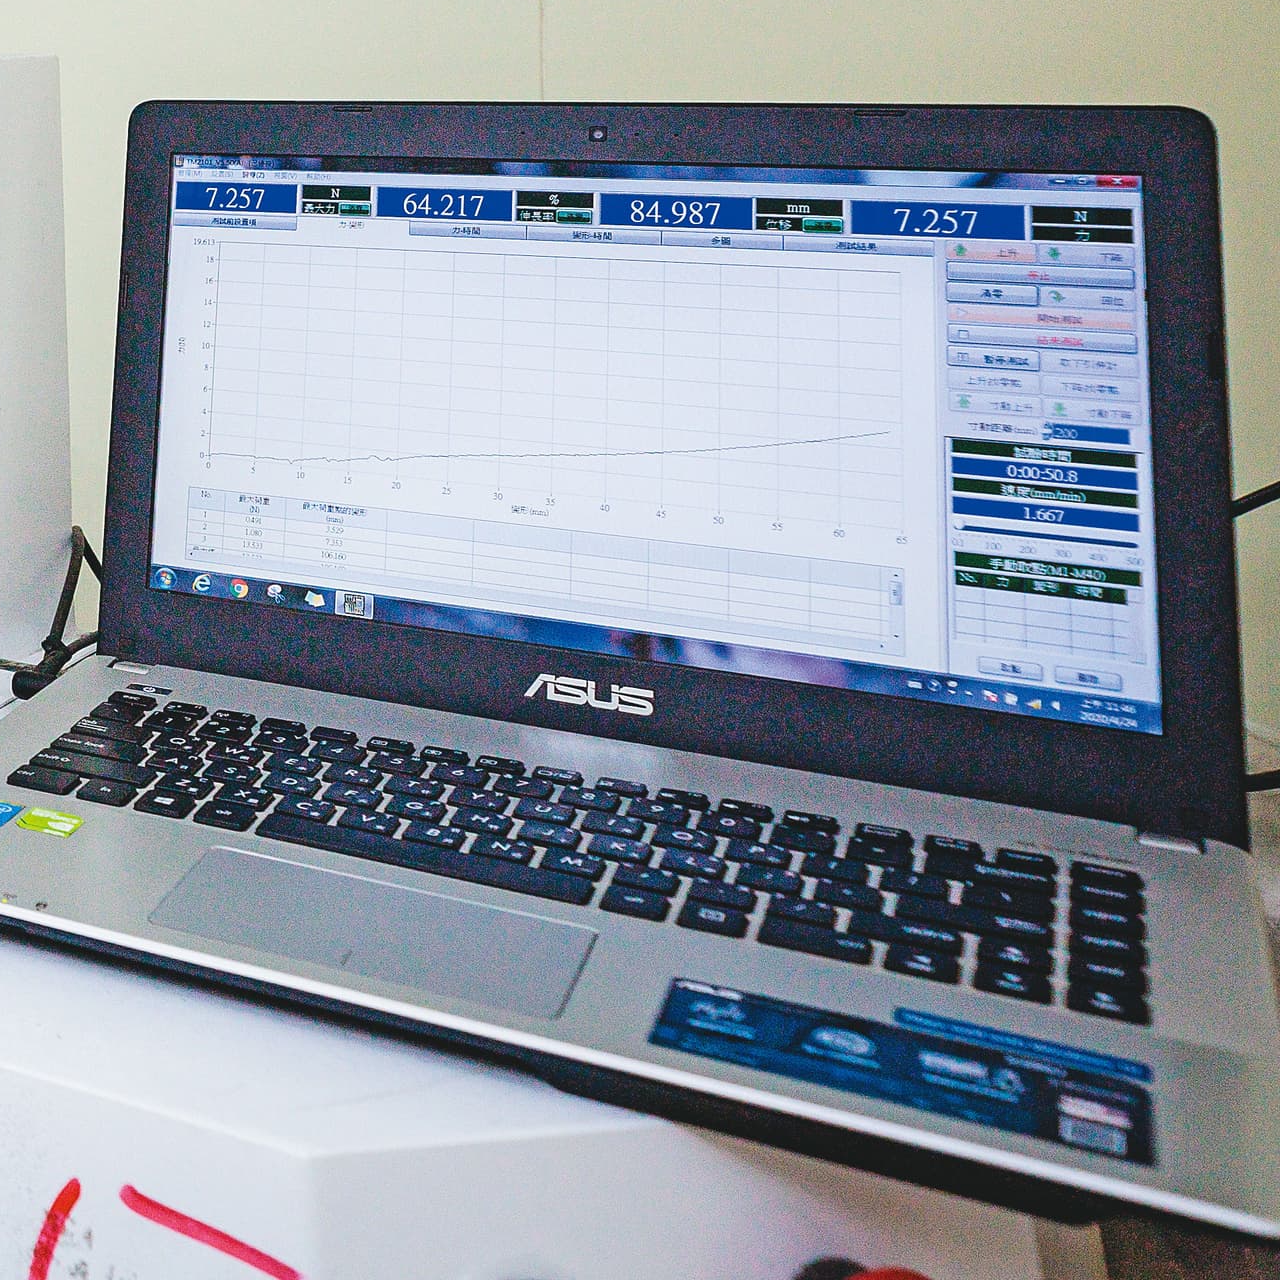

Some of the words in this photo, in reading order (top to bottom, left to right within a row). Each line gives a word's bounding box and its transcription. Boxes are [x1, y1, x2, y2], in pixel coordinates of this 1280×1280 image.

[205, 187, 265, 209] 7.257
[331, 188, 340, 199] N
[549, 194, 559, 205] %
[403, 193, 484, 217] 64.217
[630, 200, 720, 225] 84.987
[786, 204, 810, 213] mm
[893, 209, 978, 234] 7.257
[1074, 211, 1087, 222] N
[1006, 465, 1078, 483] 0:00:50.8
[1023, 507, 1064, 522] 1.667
[523, 673, 655, 716] ASUS
